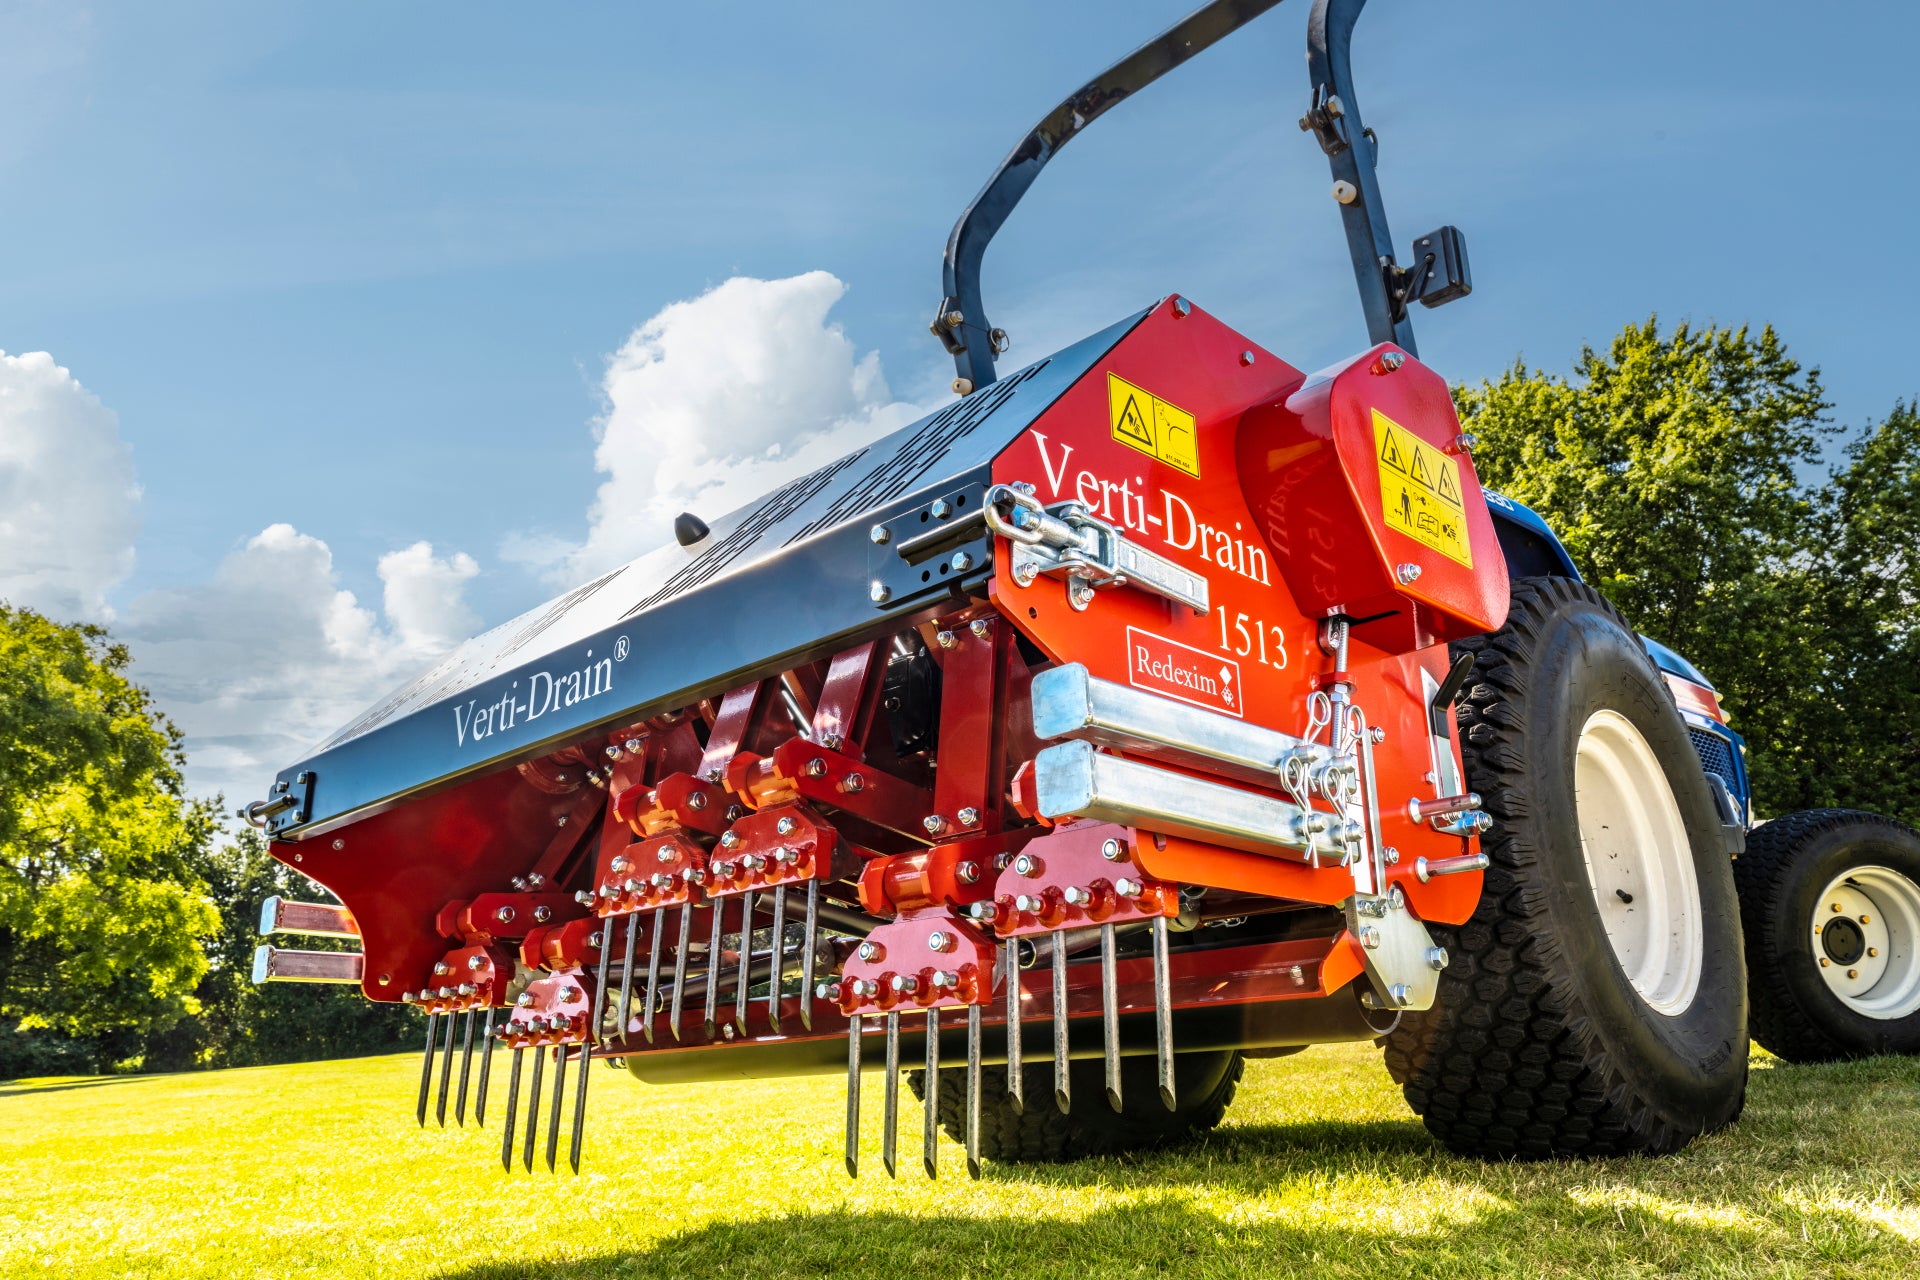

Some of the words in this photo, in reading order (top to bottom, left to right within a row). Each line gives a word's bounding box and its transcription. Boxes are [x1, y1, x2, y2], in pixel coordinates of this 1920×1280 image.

[1029, 428, 1272, 587] Verti-Drain
[1216, 605, 1288, 670] 1513
[1135, 645, 1218, 696] Redexim
